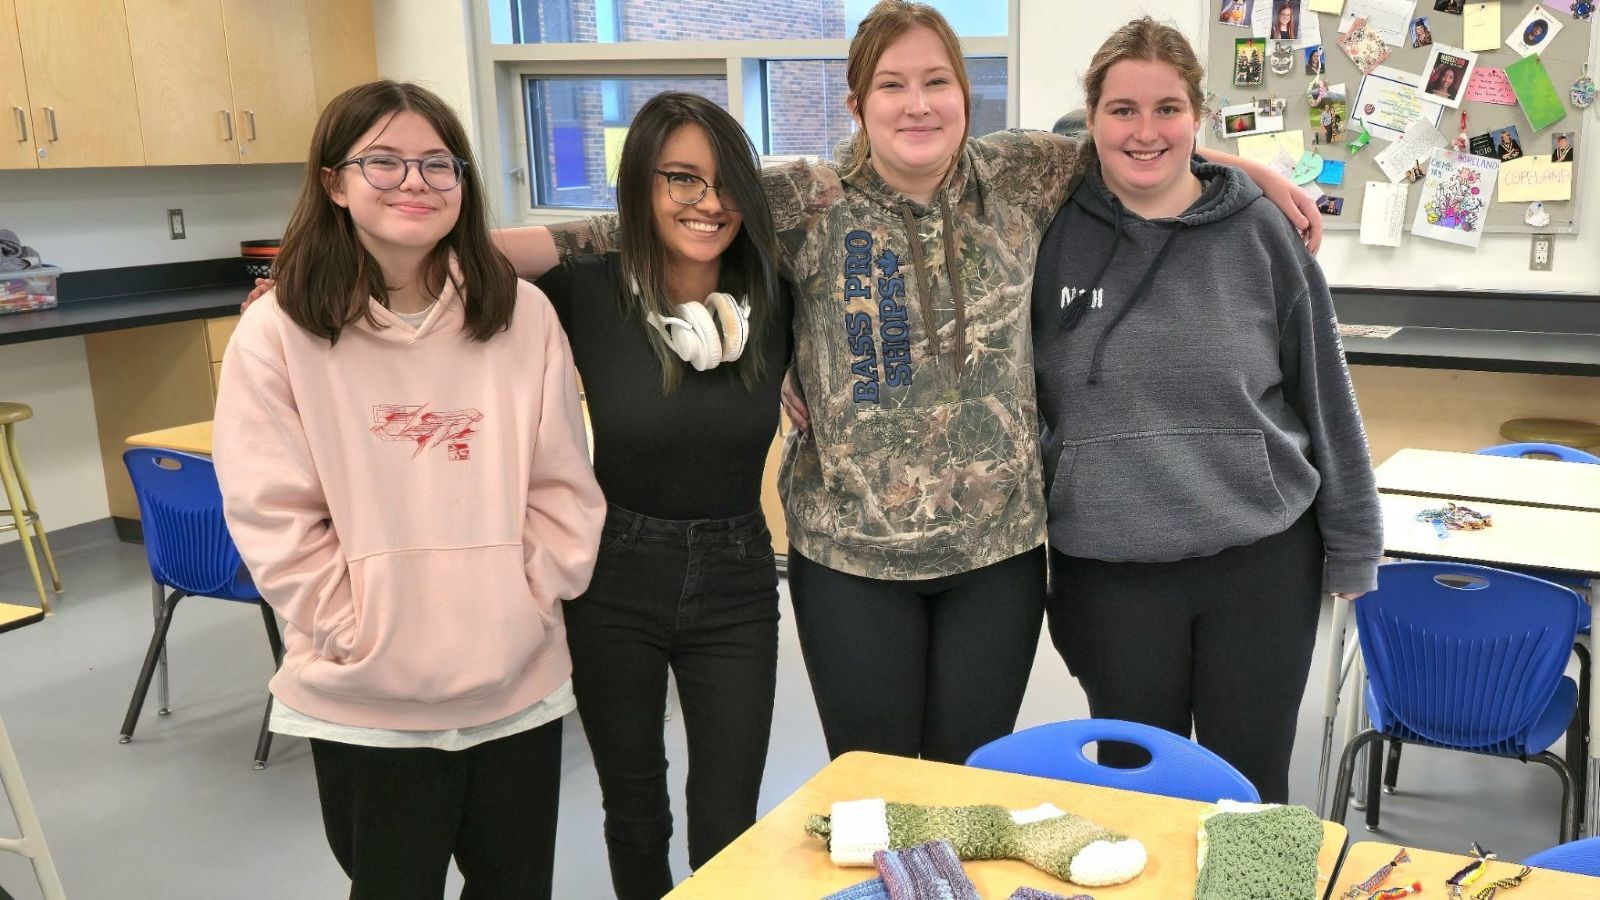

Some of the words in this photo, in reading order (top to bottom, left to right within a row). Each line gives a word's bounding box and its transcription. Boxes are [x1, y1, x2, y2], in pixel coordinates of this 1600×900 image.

[1504, 168, 1571, 186] COPELAND
[844, 229, 874, 301] PRO
[845, 311, 880, 404] BASS
[878, 274, 912, 388] SHOPS
